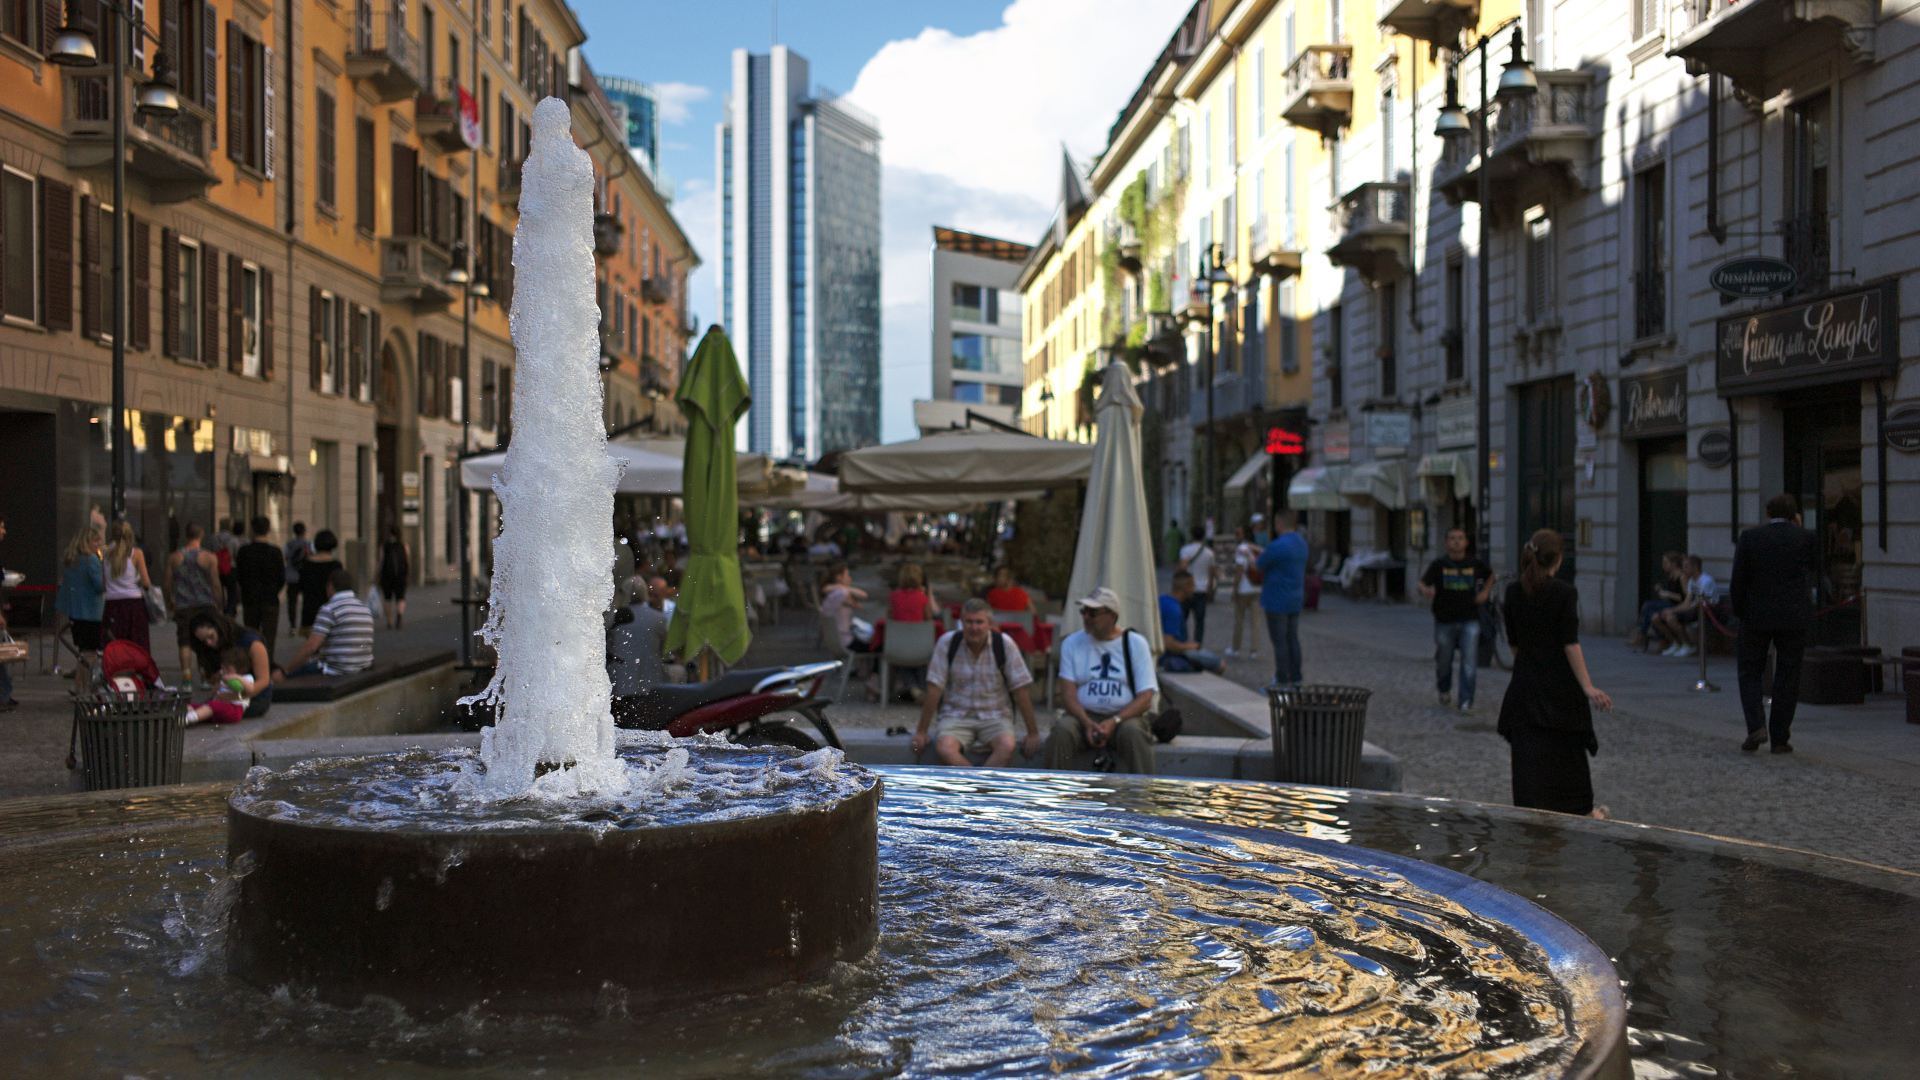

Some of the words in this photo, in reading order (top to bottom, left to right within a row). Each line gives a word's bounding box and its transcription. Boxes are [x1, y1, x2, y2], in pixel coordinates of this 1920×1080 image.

[1718, 268, 1793, 284] Insalateria
[1743, 317, 1786, 375] Cucina
[1804, 294, 1879, 365] Langhe
[1623, 380, 1687, 431] Ristorante
[1088, 682, 1122, 697] RUN
